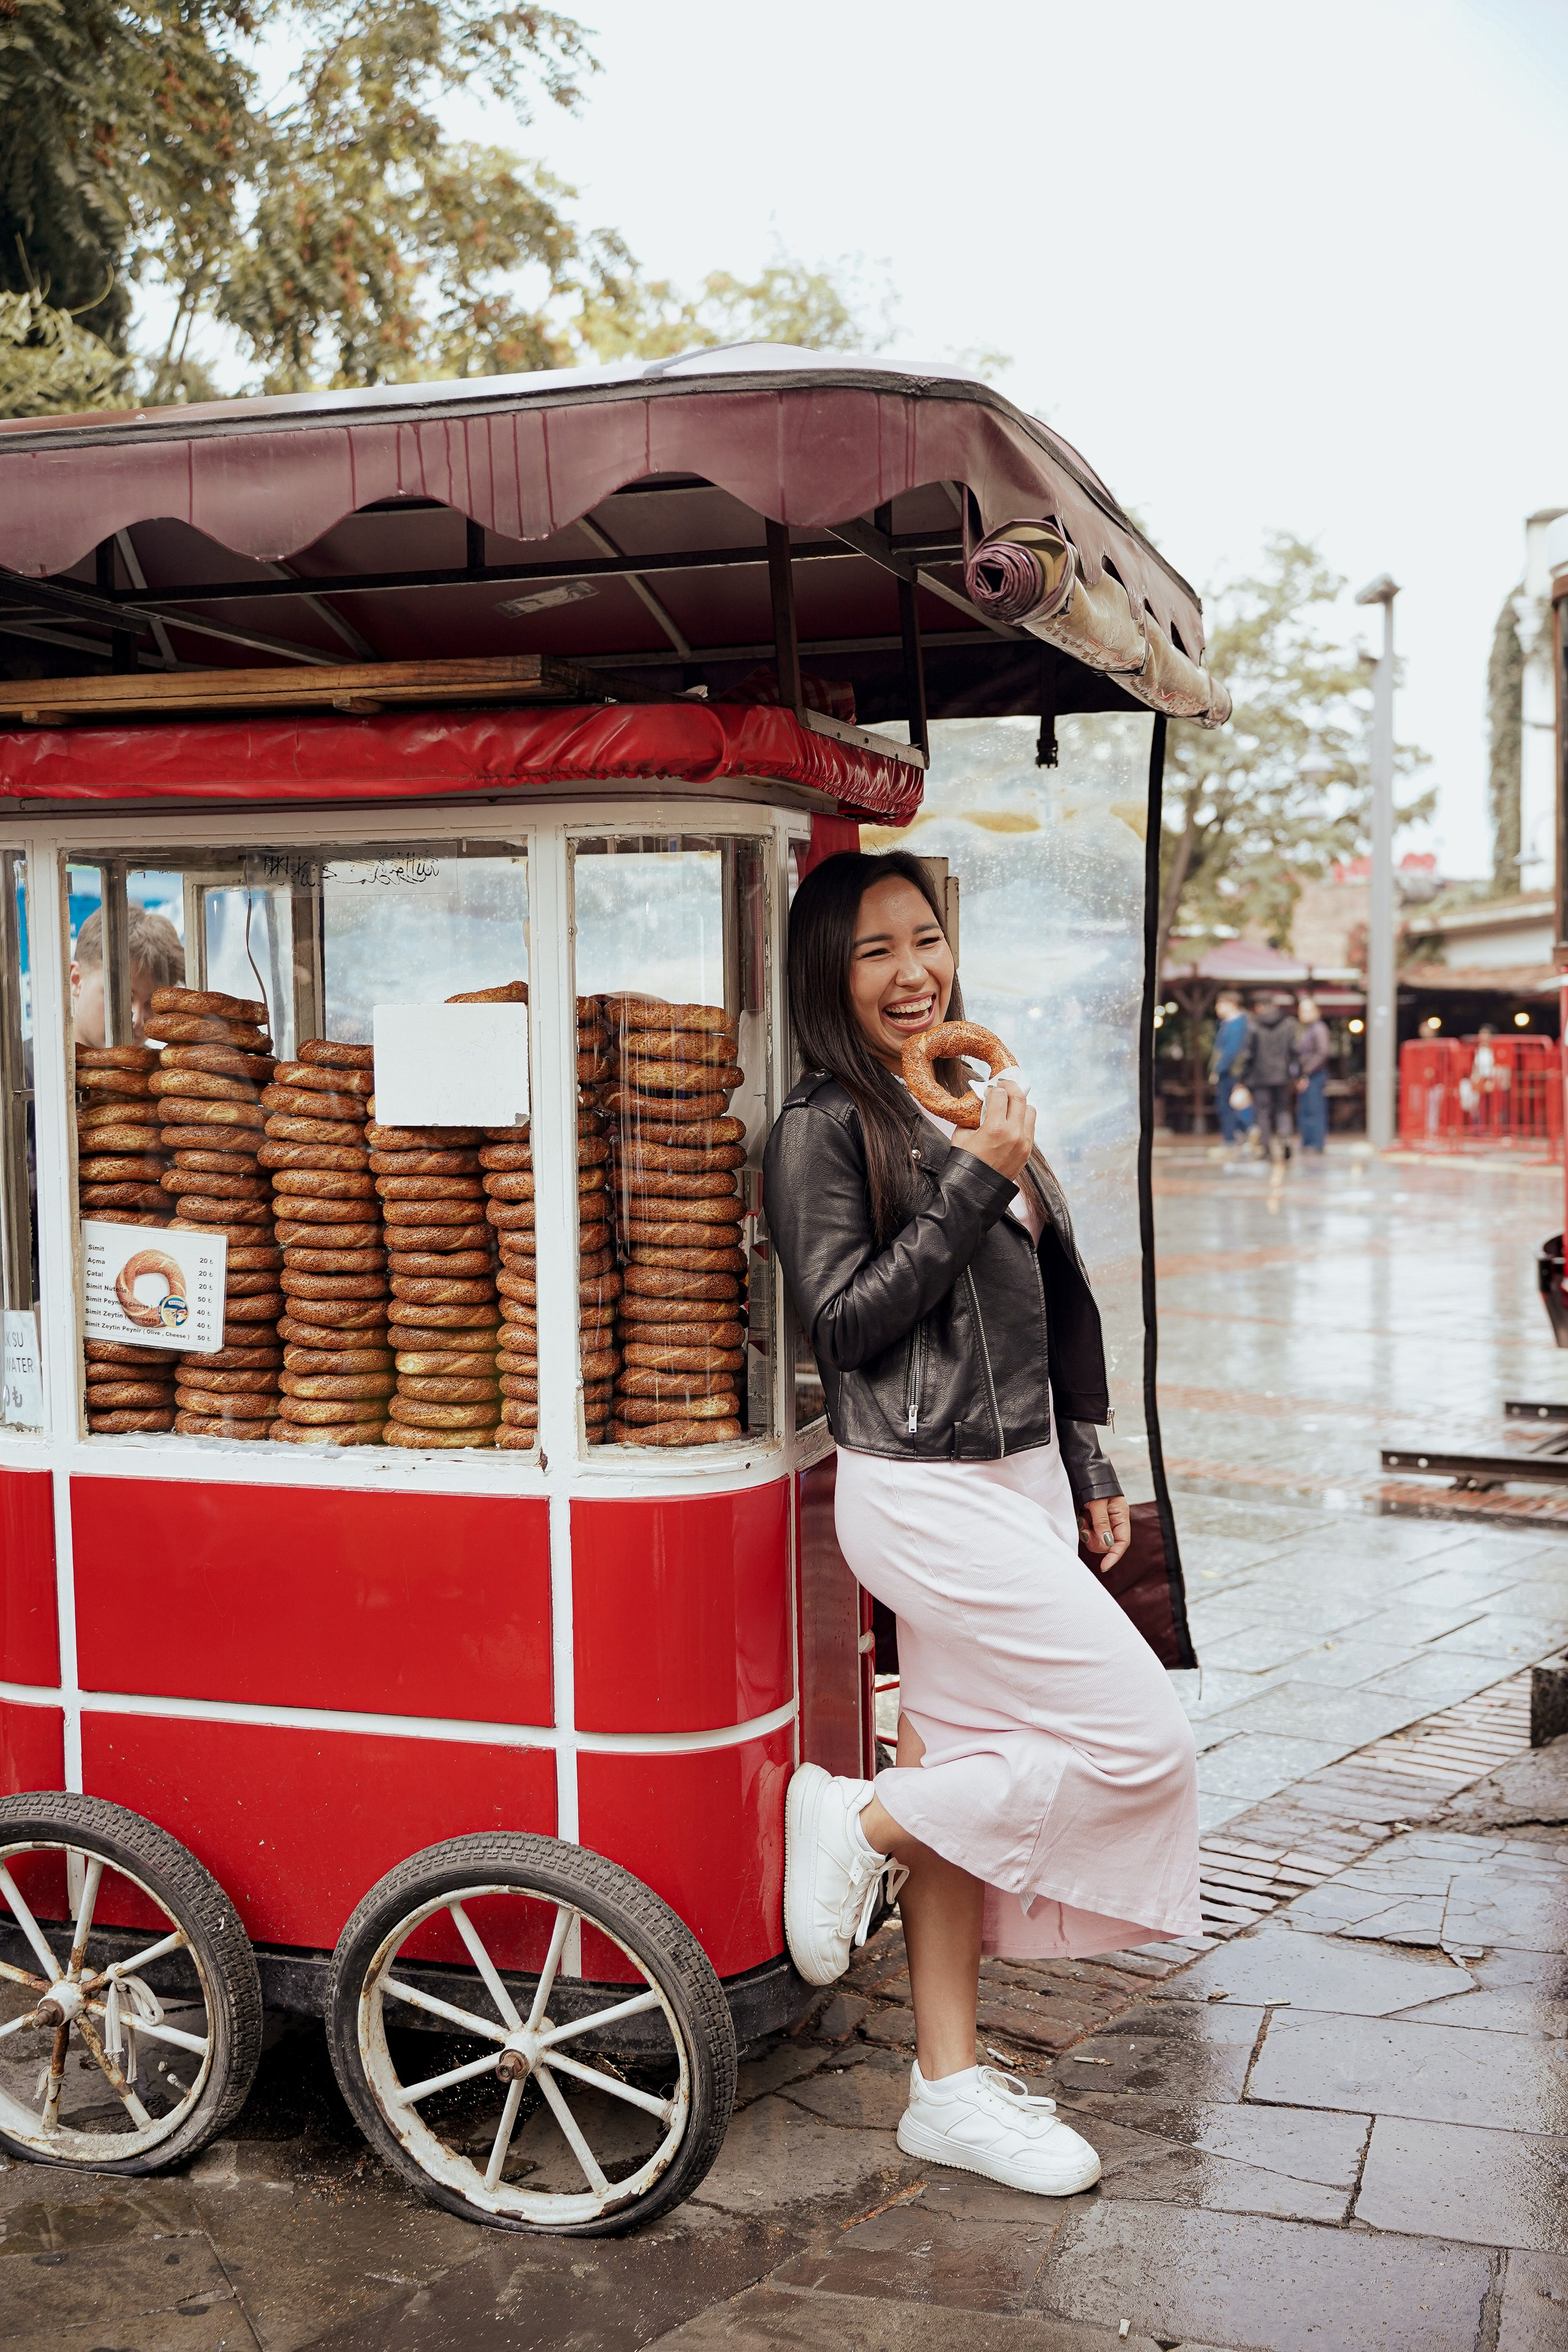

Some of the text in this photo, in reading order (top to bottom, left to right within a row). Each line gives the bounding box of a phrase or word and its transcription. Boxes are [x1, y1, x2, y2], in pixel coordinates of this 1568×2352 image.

[104, 1284, 127, 1293] Nutella
[103, 1311, 123, 1319] Zeytin
[102, 1323, 121, 1332] Zeytin
[123, 1325, 141, 1335] Peynir
